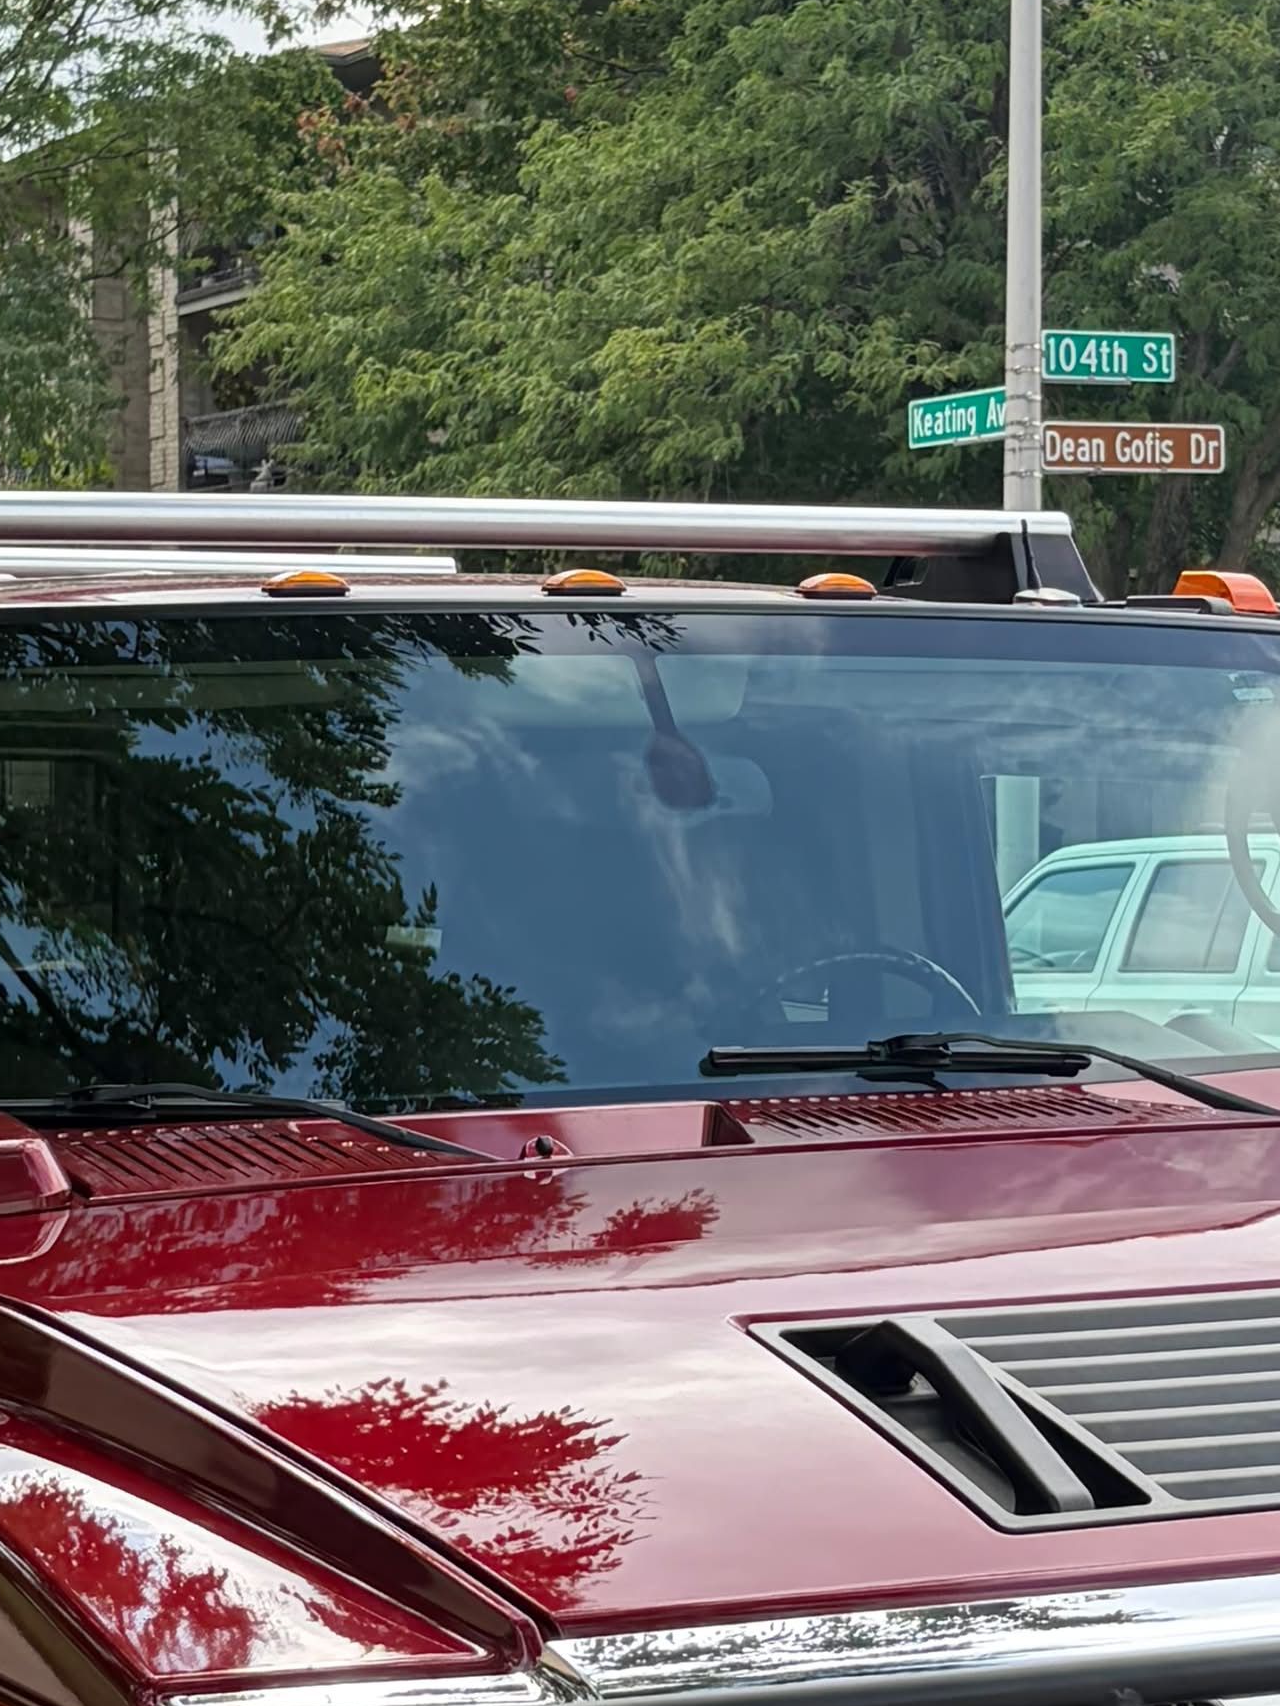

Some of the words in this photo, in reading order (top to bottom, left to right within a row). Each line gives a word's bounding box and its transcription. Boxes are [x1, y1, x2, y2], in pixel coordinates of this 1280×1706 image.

[1047, 337, 1129, 374] 104th
[1142, 341, 1171, 375] St
[912, 403, 978, 440] Keating
[986, 396, 1007, 428] Av
[1045, 431, 1105, 463] Dean
[1115, 432, 1174, 464] Gofis
[1191, 433, 1219, 465] Dr
